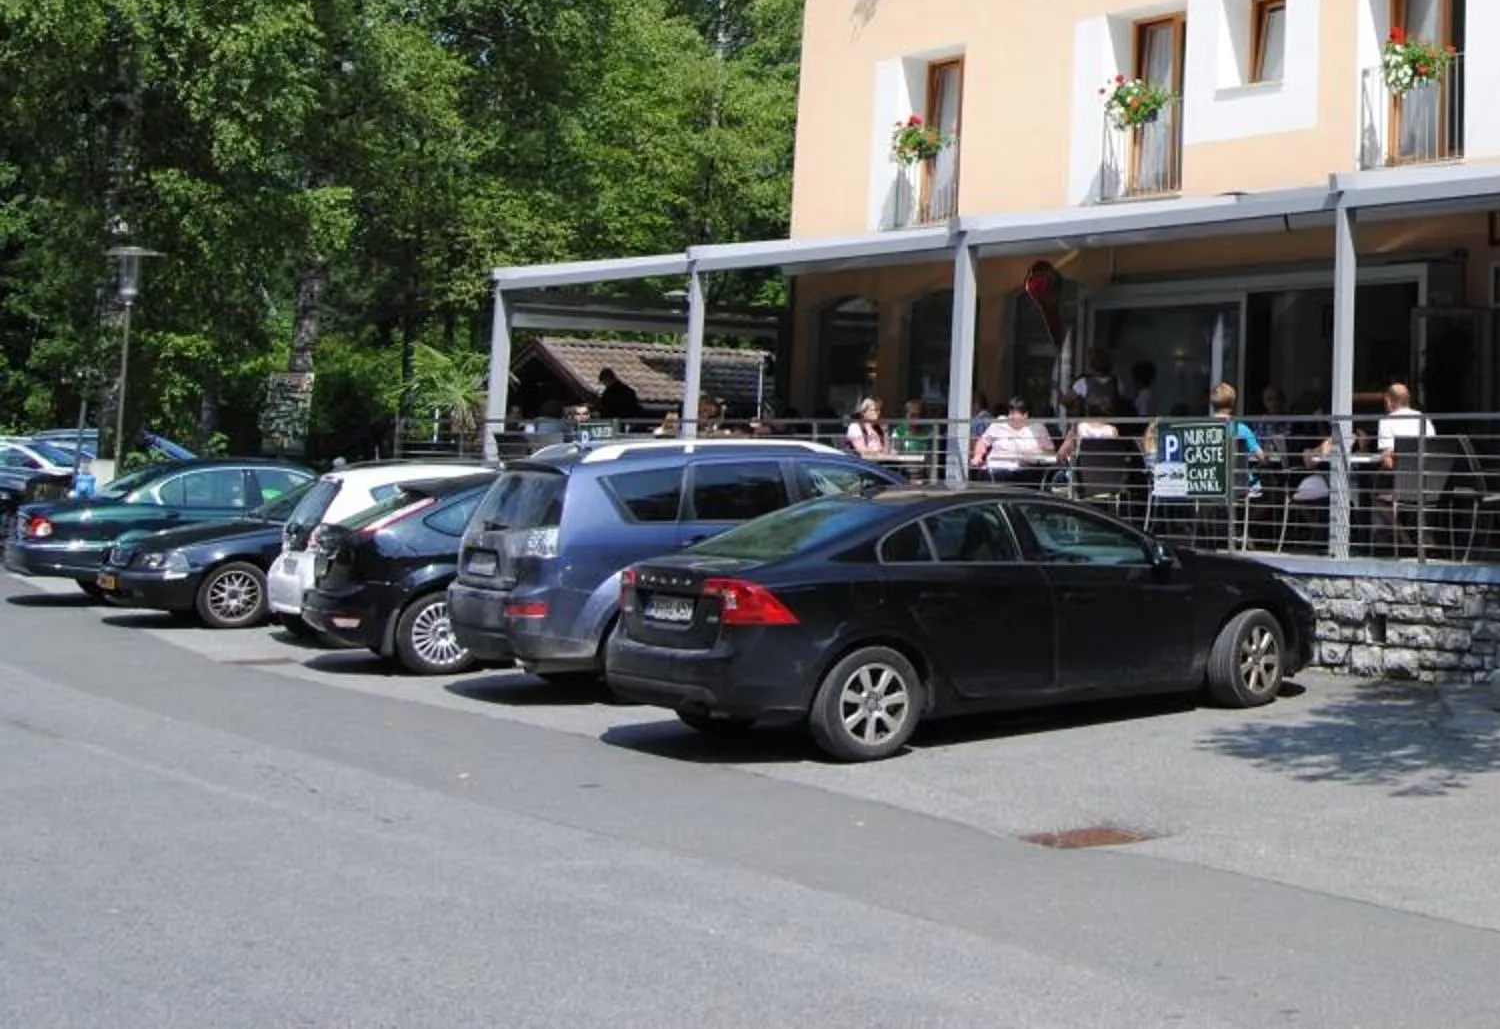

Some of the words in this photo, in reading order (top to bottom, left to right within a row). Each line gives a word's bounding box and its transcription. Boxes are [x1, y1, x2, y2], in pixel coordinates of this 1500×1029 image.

[1183, 428, 1205, 445] NUR
[1165, 434, 1179, 462] P
[1183, 445, 1225, 464] GÄSTE
